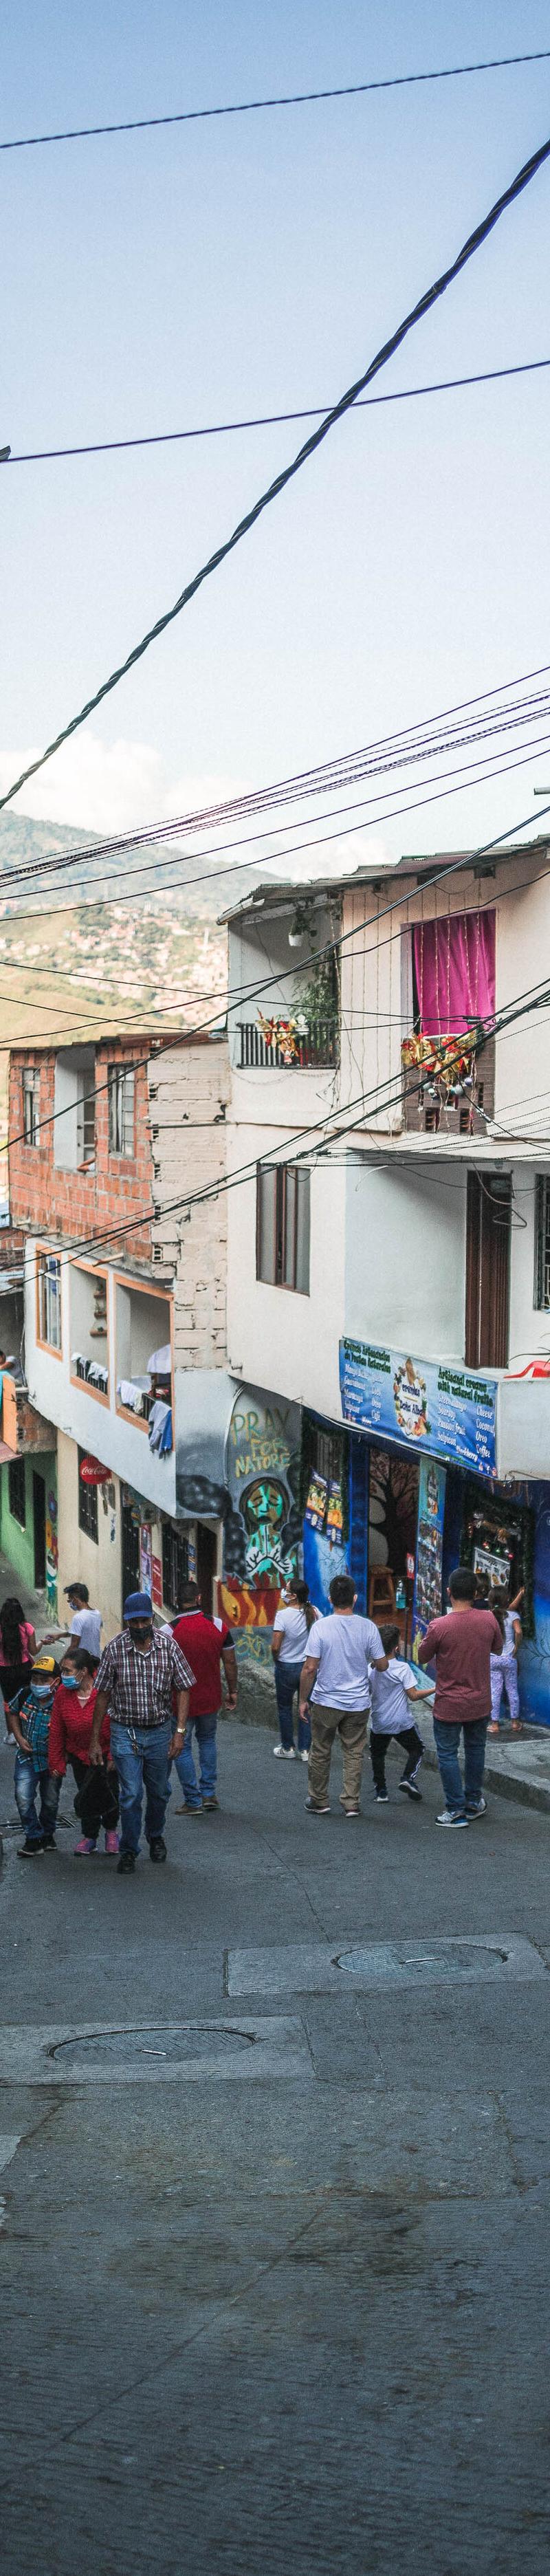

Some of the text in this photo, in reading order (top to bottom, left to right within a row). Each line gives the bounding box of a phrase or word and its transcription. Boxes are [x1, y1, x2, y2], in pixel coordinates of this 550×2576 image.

[439, 1366, 465, 1386] Artisanal
[438, 1381, 450, 1394] with
[451, 1385, 473, 1401] natural
[476, 1405, 493, 1419] Cheese
[230, 1408, 290, 1445] PRAY
[476, 1418, 496, 1435] Coconut
[476, 1431, 487, 1444] Oreo
[476, 1444, 491, 1459] Coffee
